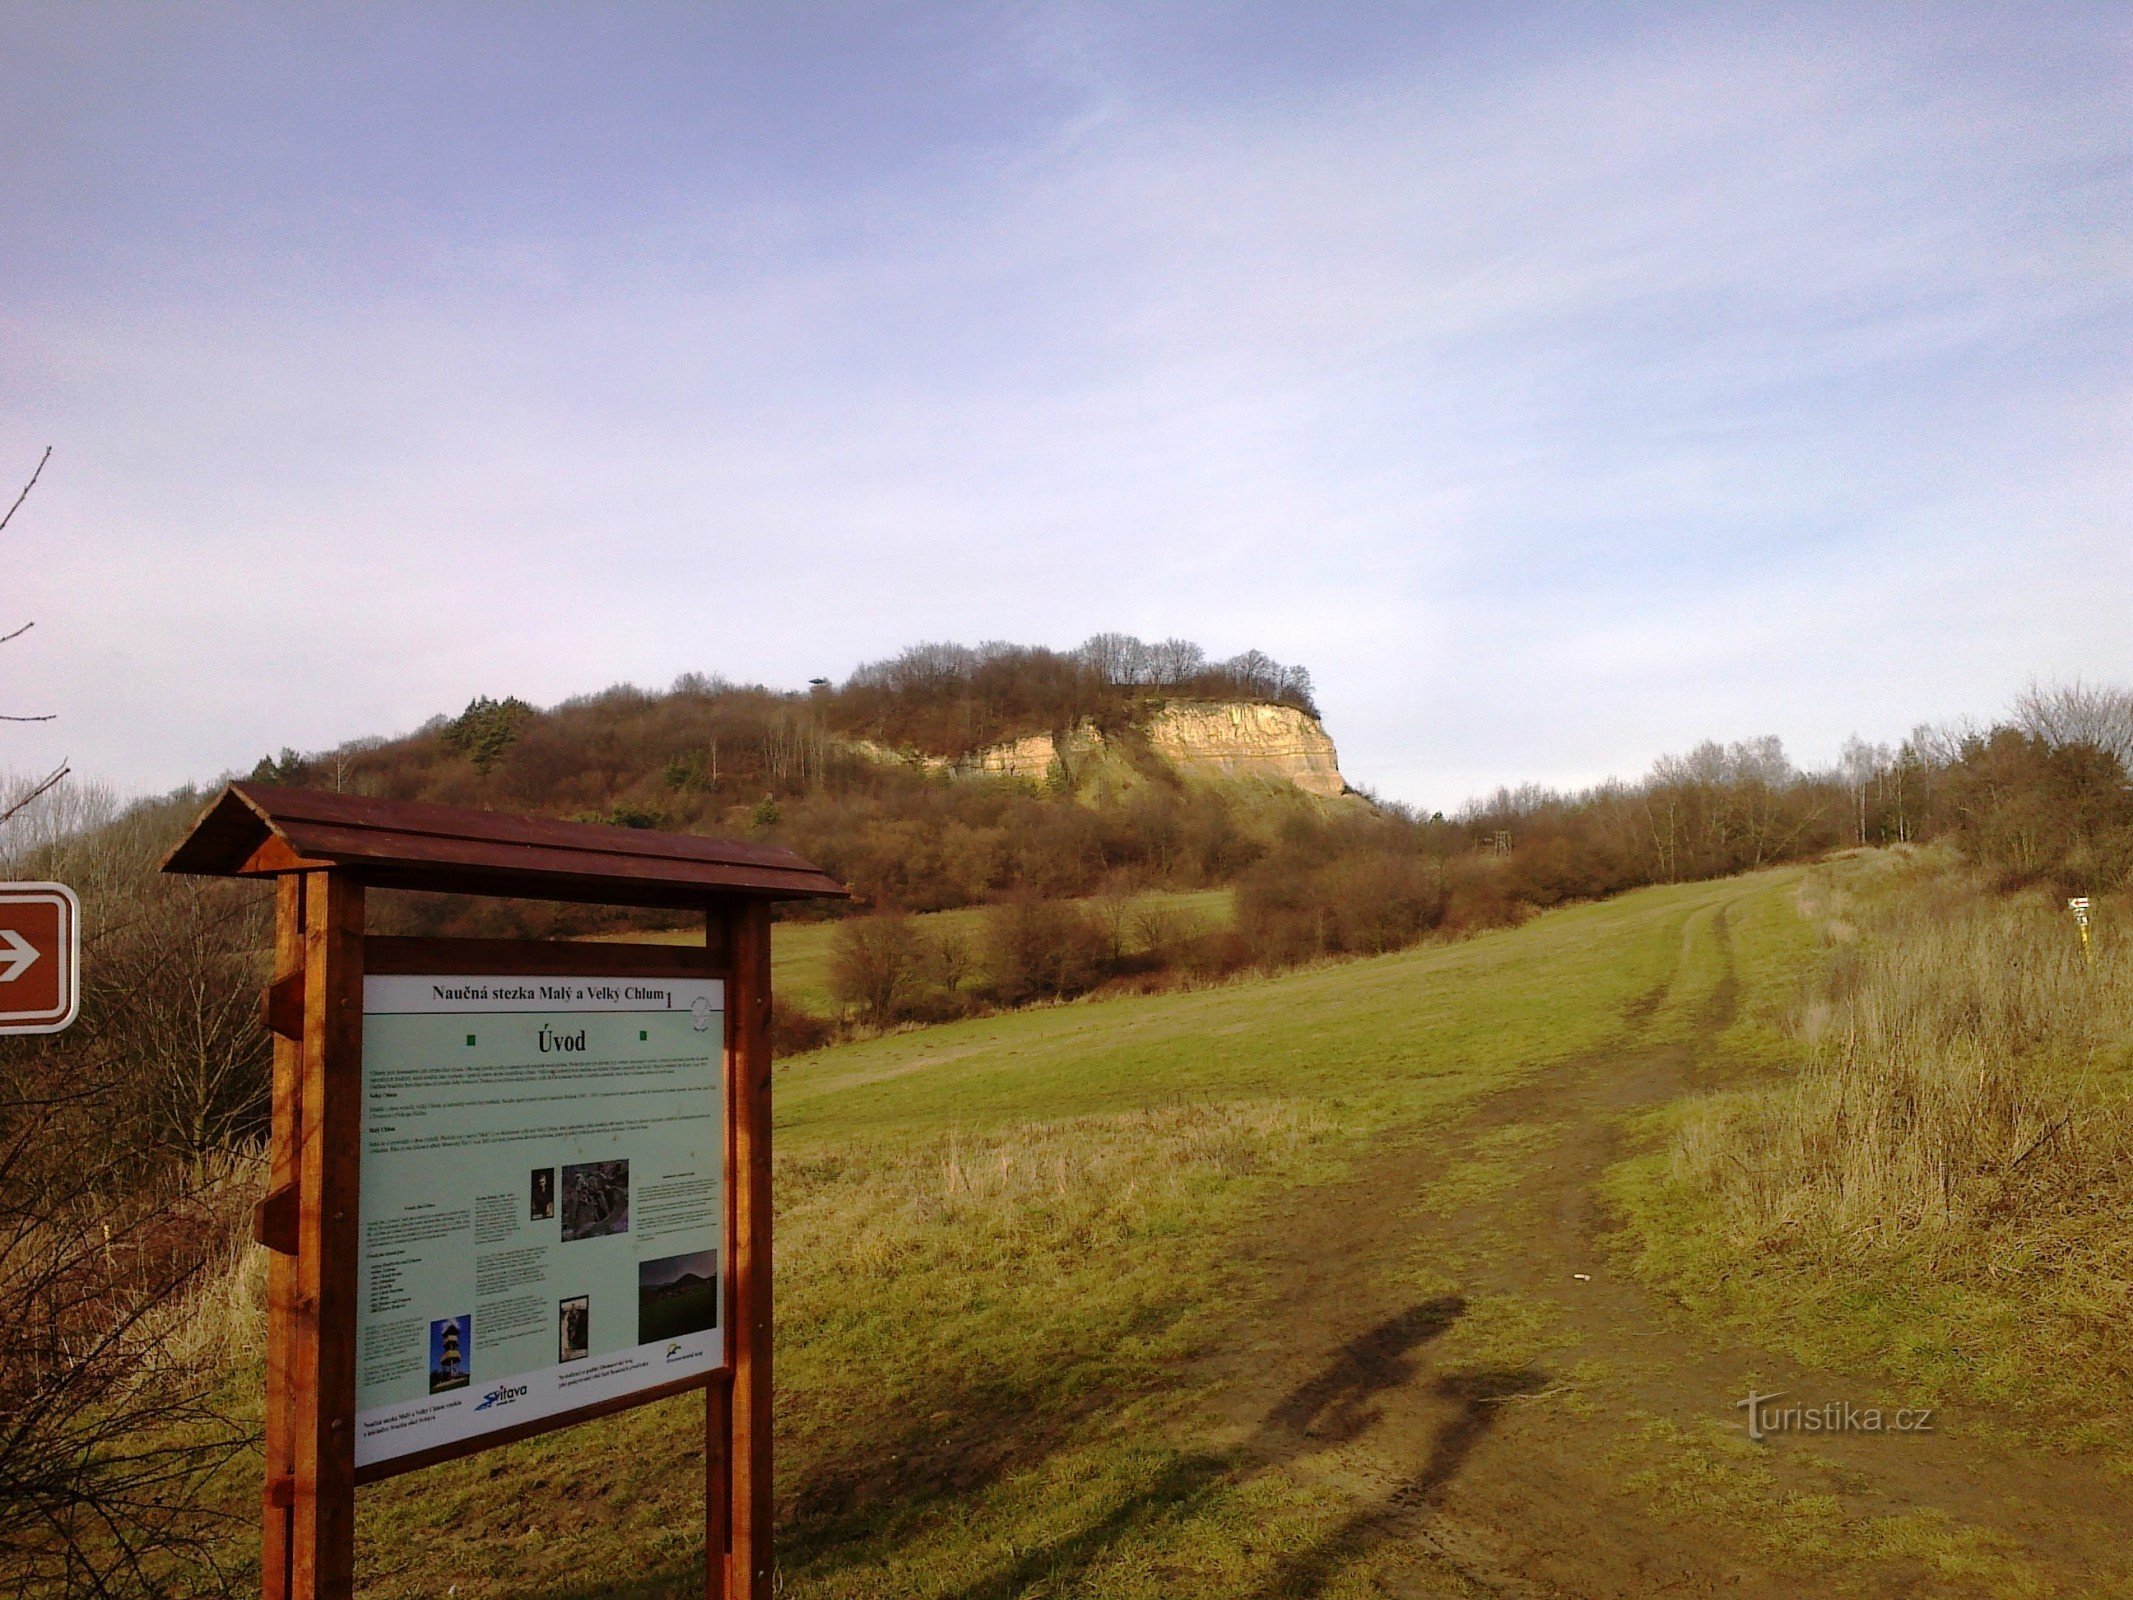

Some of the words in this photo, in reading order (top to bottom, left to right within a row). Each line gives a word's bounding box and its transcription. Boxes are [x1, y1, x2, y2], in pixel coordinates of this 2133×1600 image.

[432, 985, 488, 1000] Naučná
[492, 986, 535, 1000] stezka
[540, 986, 573, 1003] Malý
[576, 989, 584, 1000] a
[587, 986, 621, 1003] Velký
[624, 986, 664, 1000] Chlum
[666, 991, 672, 1008] 1
[538, 1023, 587, 1053] Úvod
